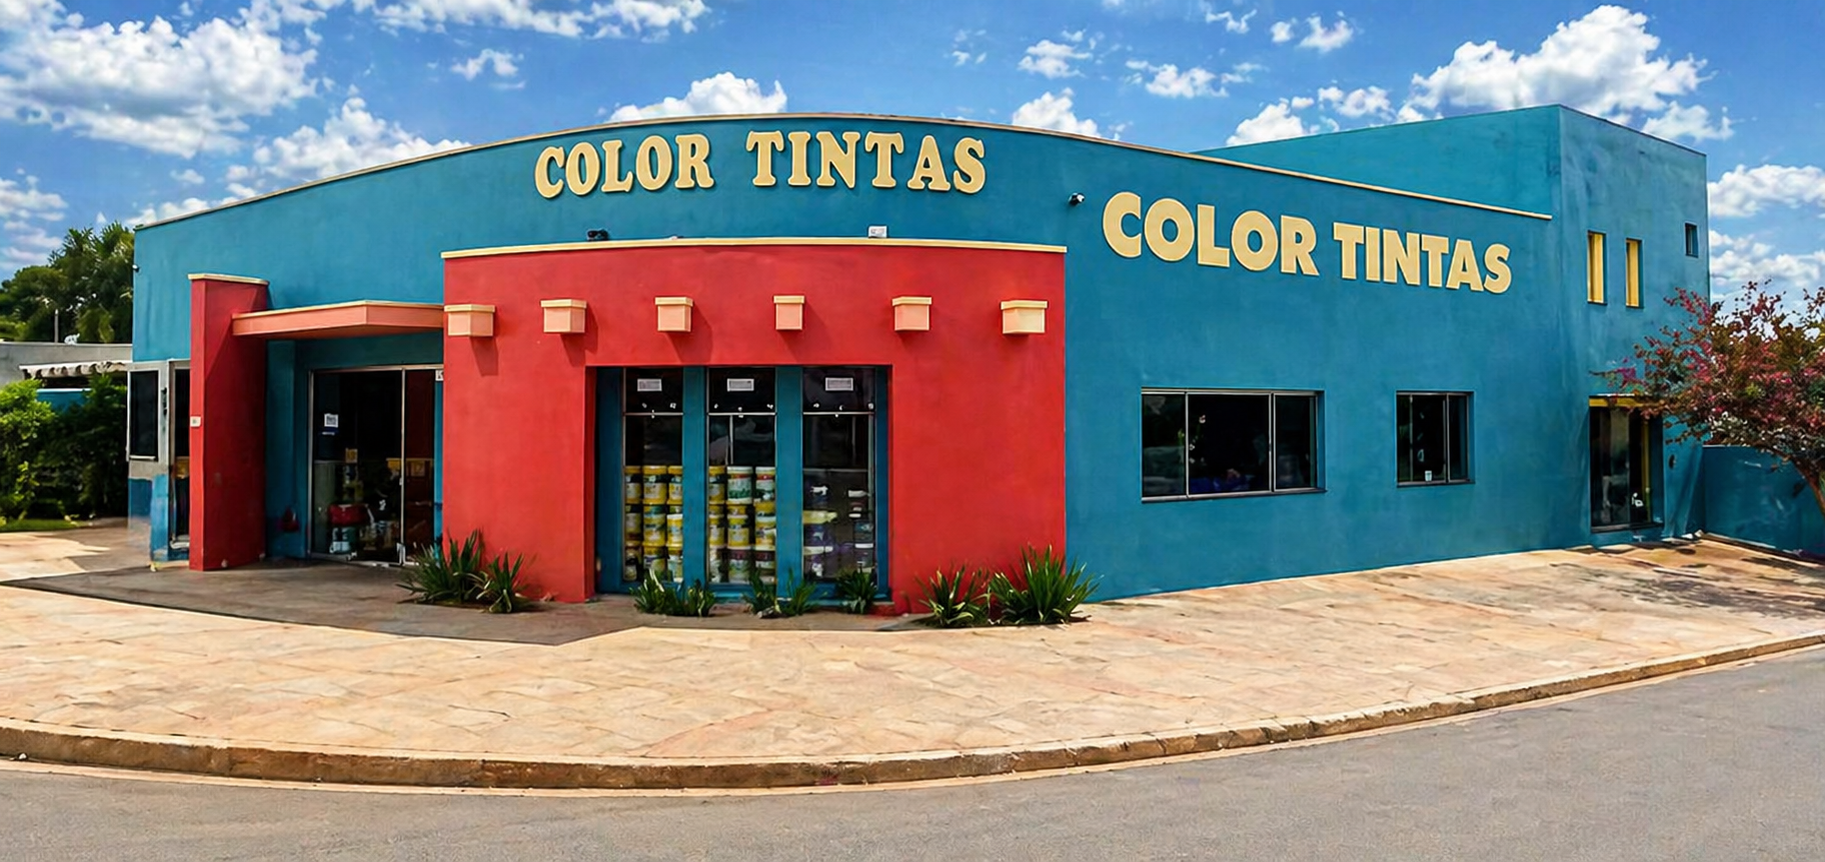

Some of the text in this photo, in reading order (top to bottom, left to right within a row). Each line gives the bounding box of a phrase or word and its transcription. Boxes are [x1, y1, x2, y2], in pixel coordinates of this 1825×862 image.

[534, 131, 987, 198] COLOR TINTAS
[1103, 191, 1512, 294] COLOR TINTAS
